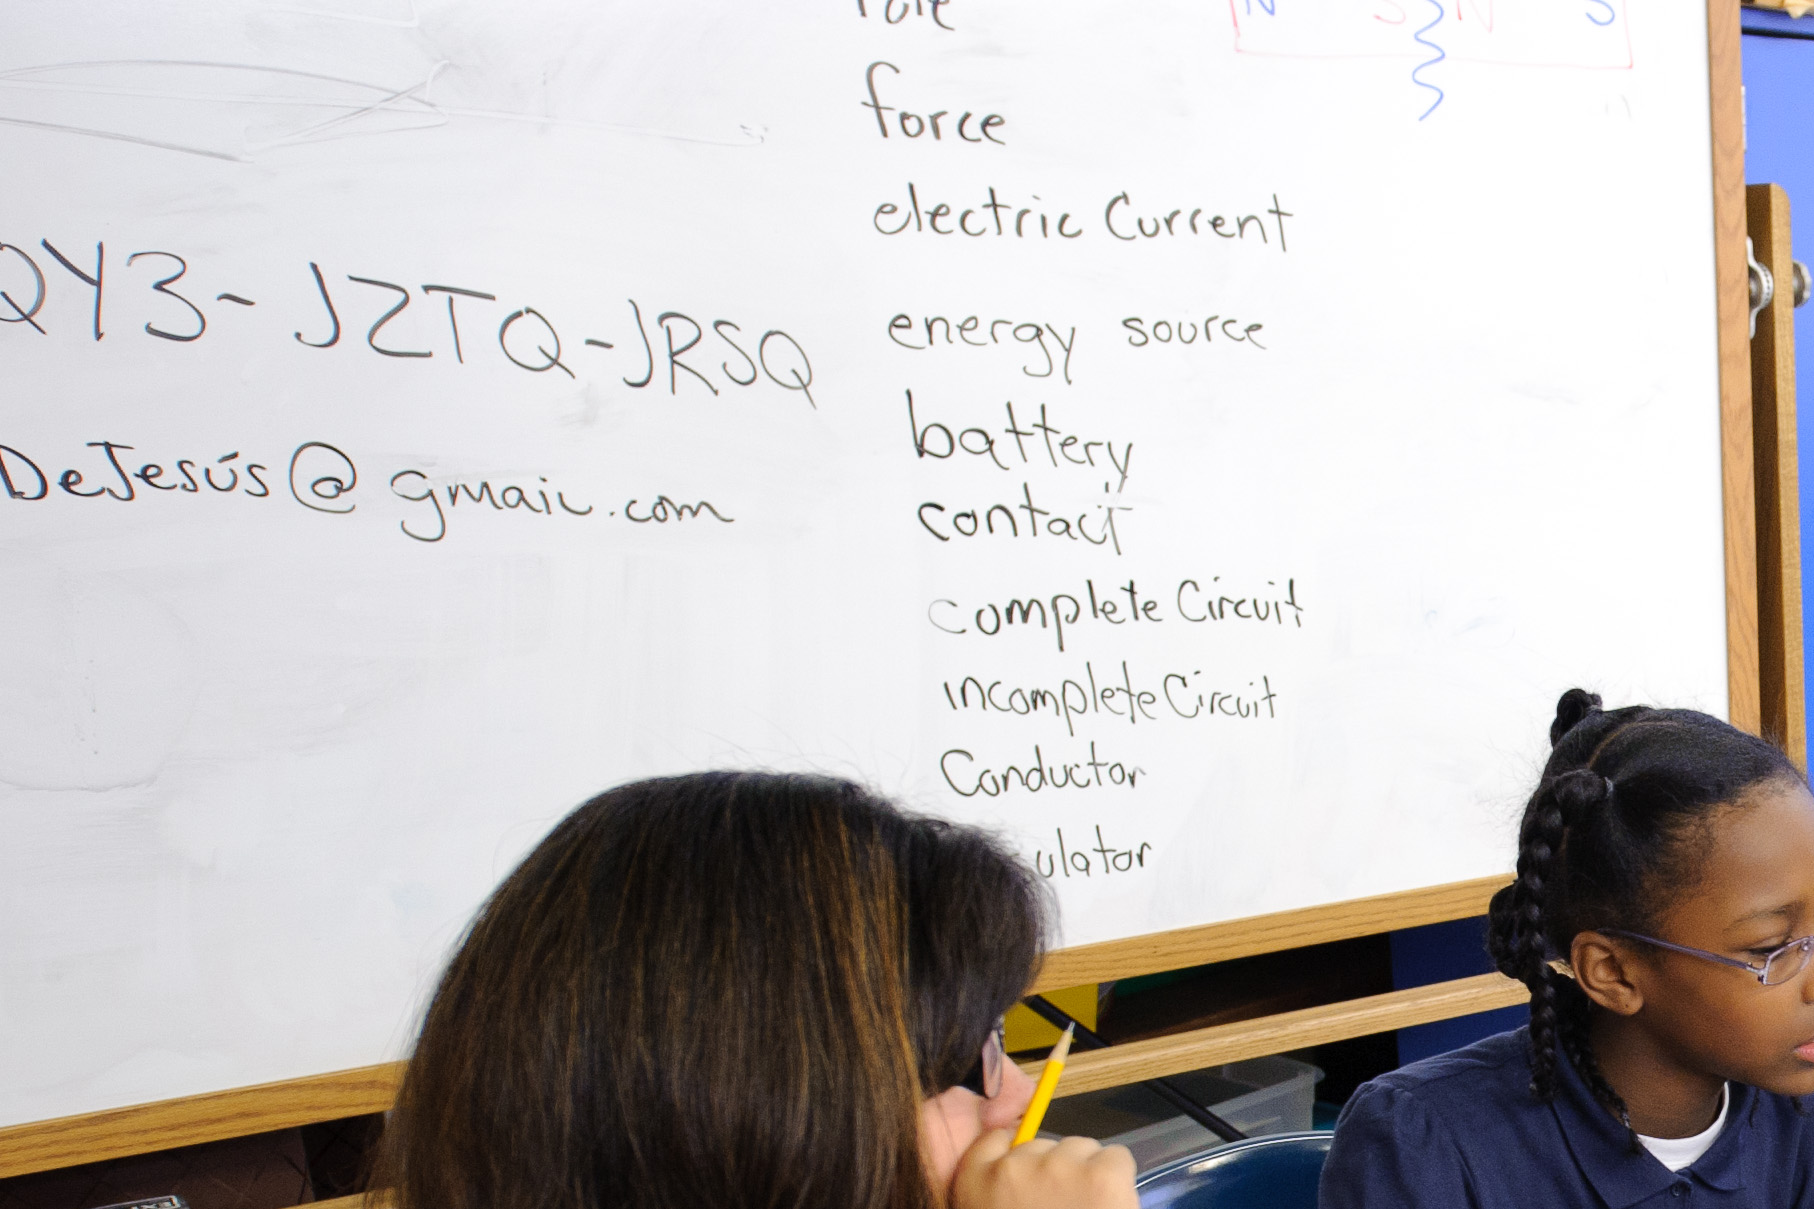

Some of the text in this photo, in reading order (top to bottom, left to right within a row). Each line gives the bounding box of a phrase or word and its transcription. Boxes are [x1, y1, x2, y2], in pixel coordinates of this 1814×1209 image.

[860, 60, 1006, 146] force
[873, 182, 1083, 241] electric
[887, 312, 1267, 385] energy source
[905, 388, 1134, 494] battery
[917, 482, 1133, 556] contact
[927, 579, 1164, 652] complete
